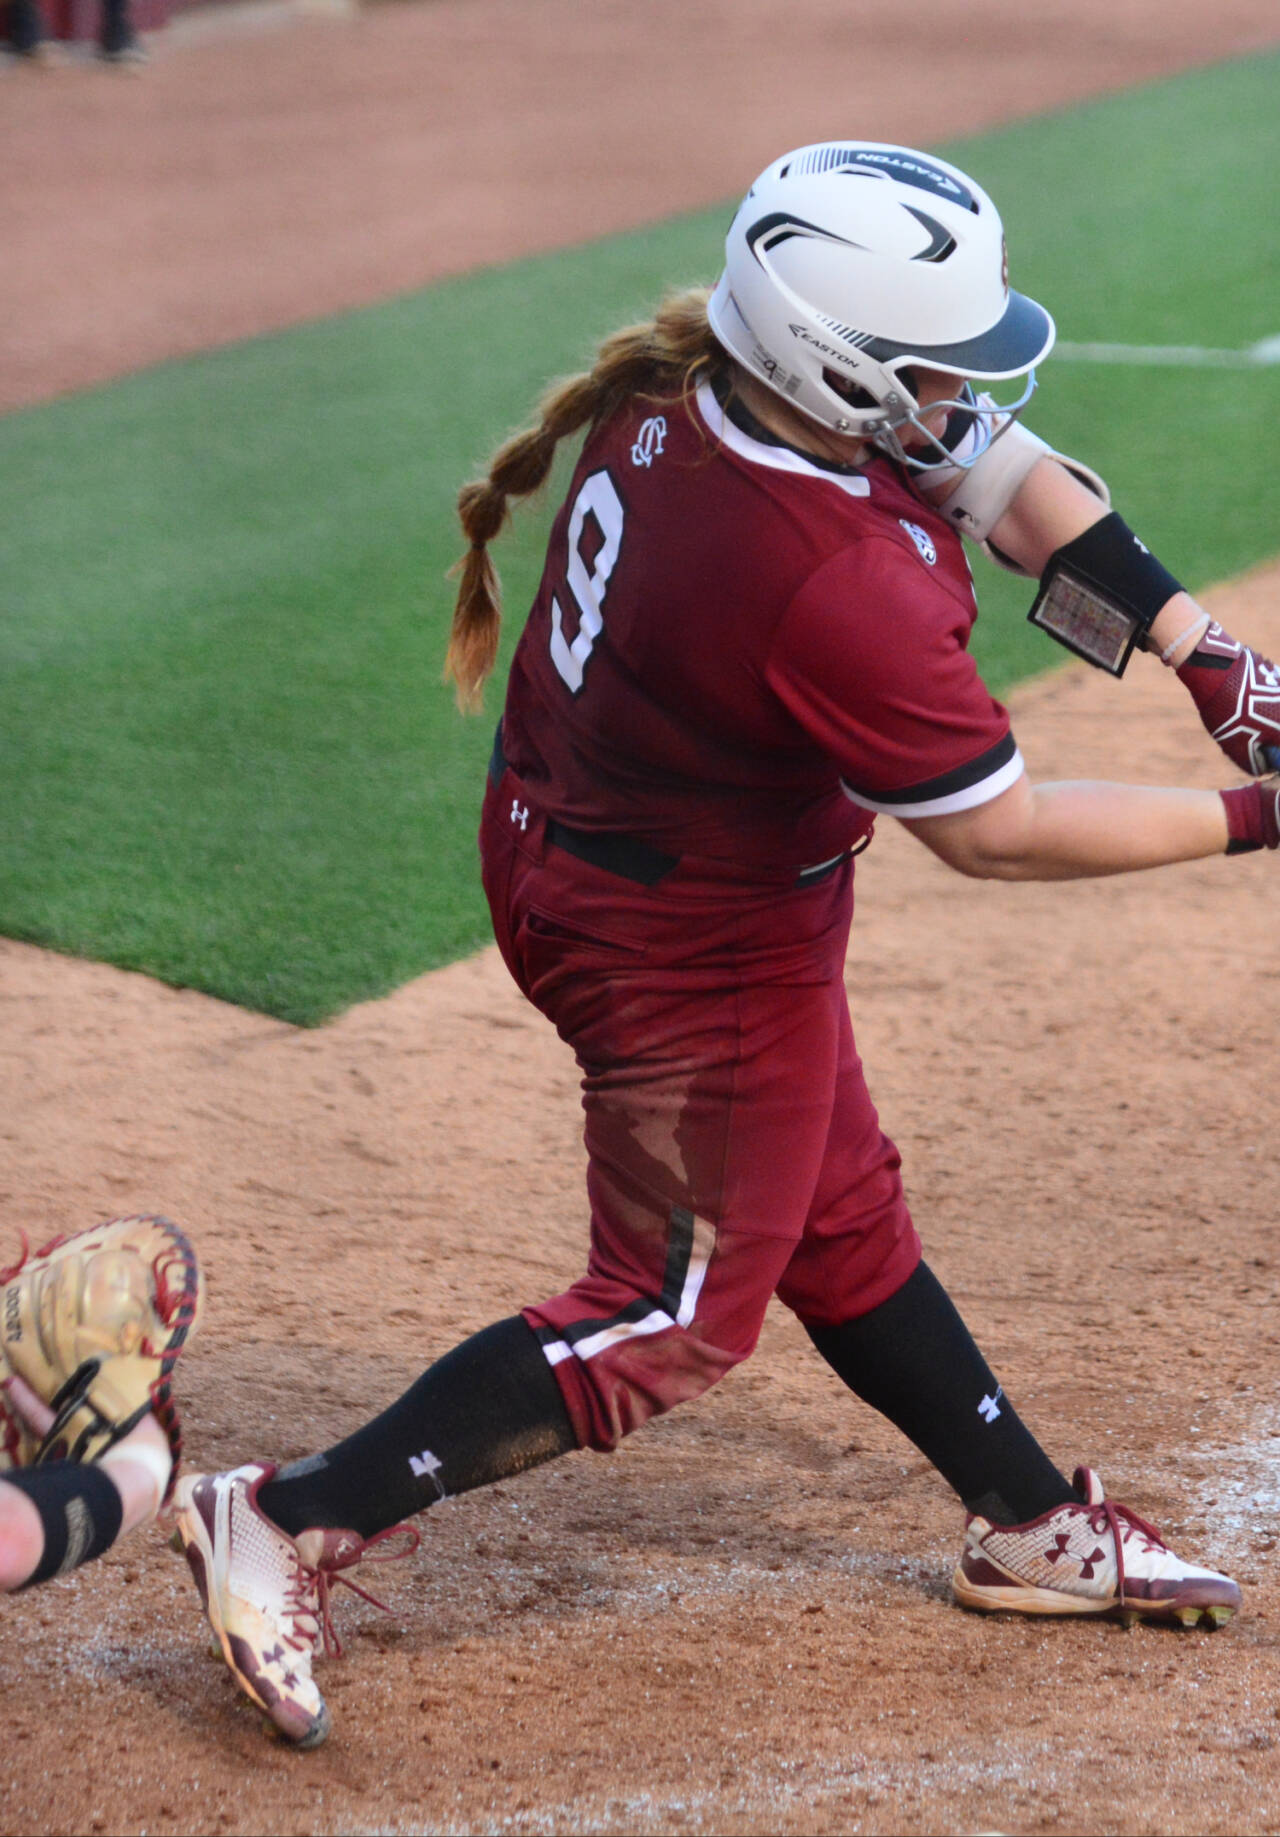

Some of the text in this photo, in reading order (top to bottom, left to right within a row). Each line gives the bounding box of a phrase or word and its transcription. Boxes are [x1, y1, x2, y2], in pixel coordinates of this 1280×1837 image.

[856, 153, 944, 182] EASTON
[801, 333, 859, 368] EASTON
[549, 468, 625, 694] 9
